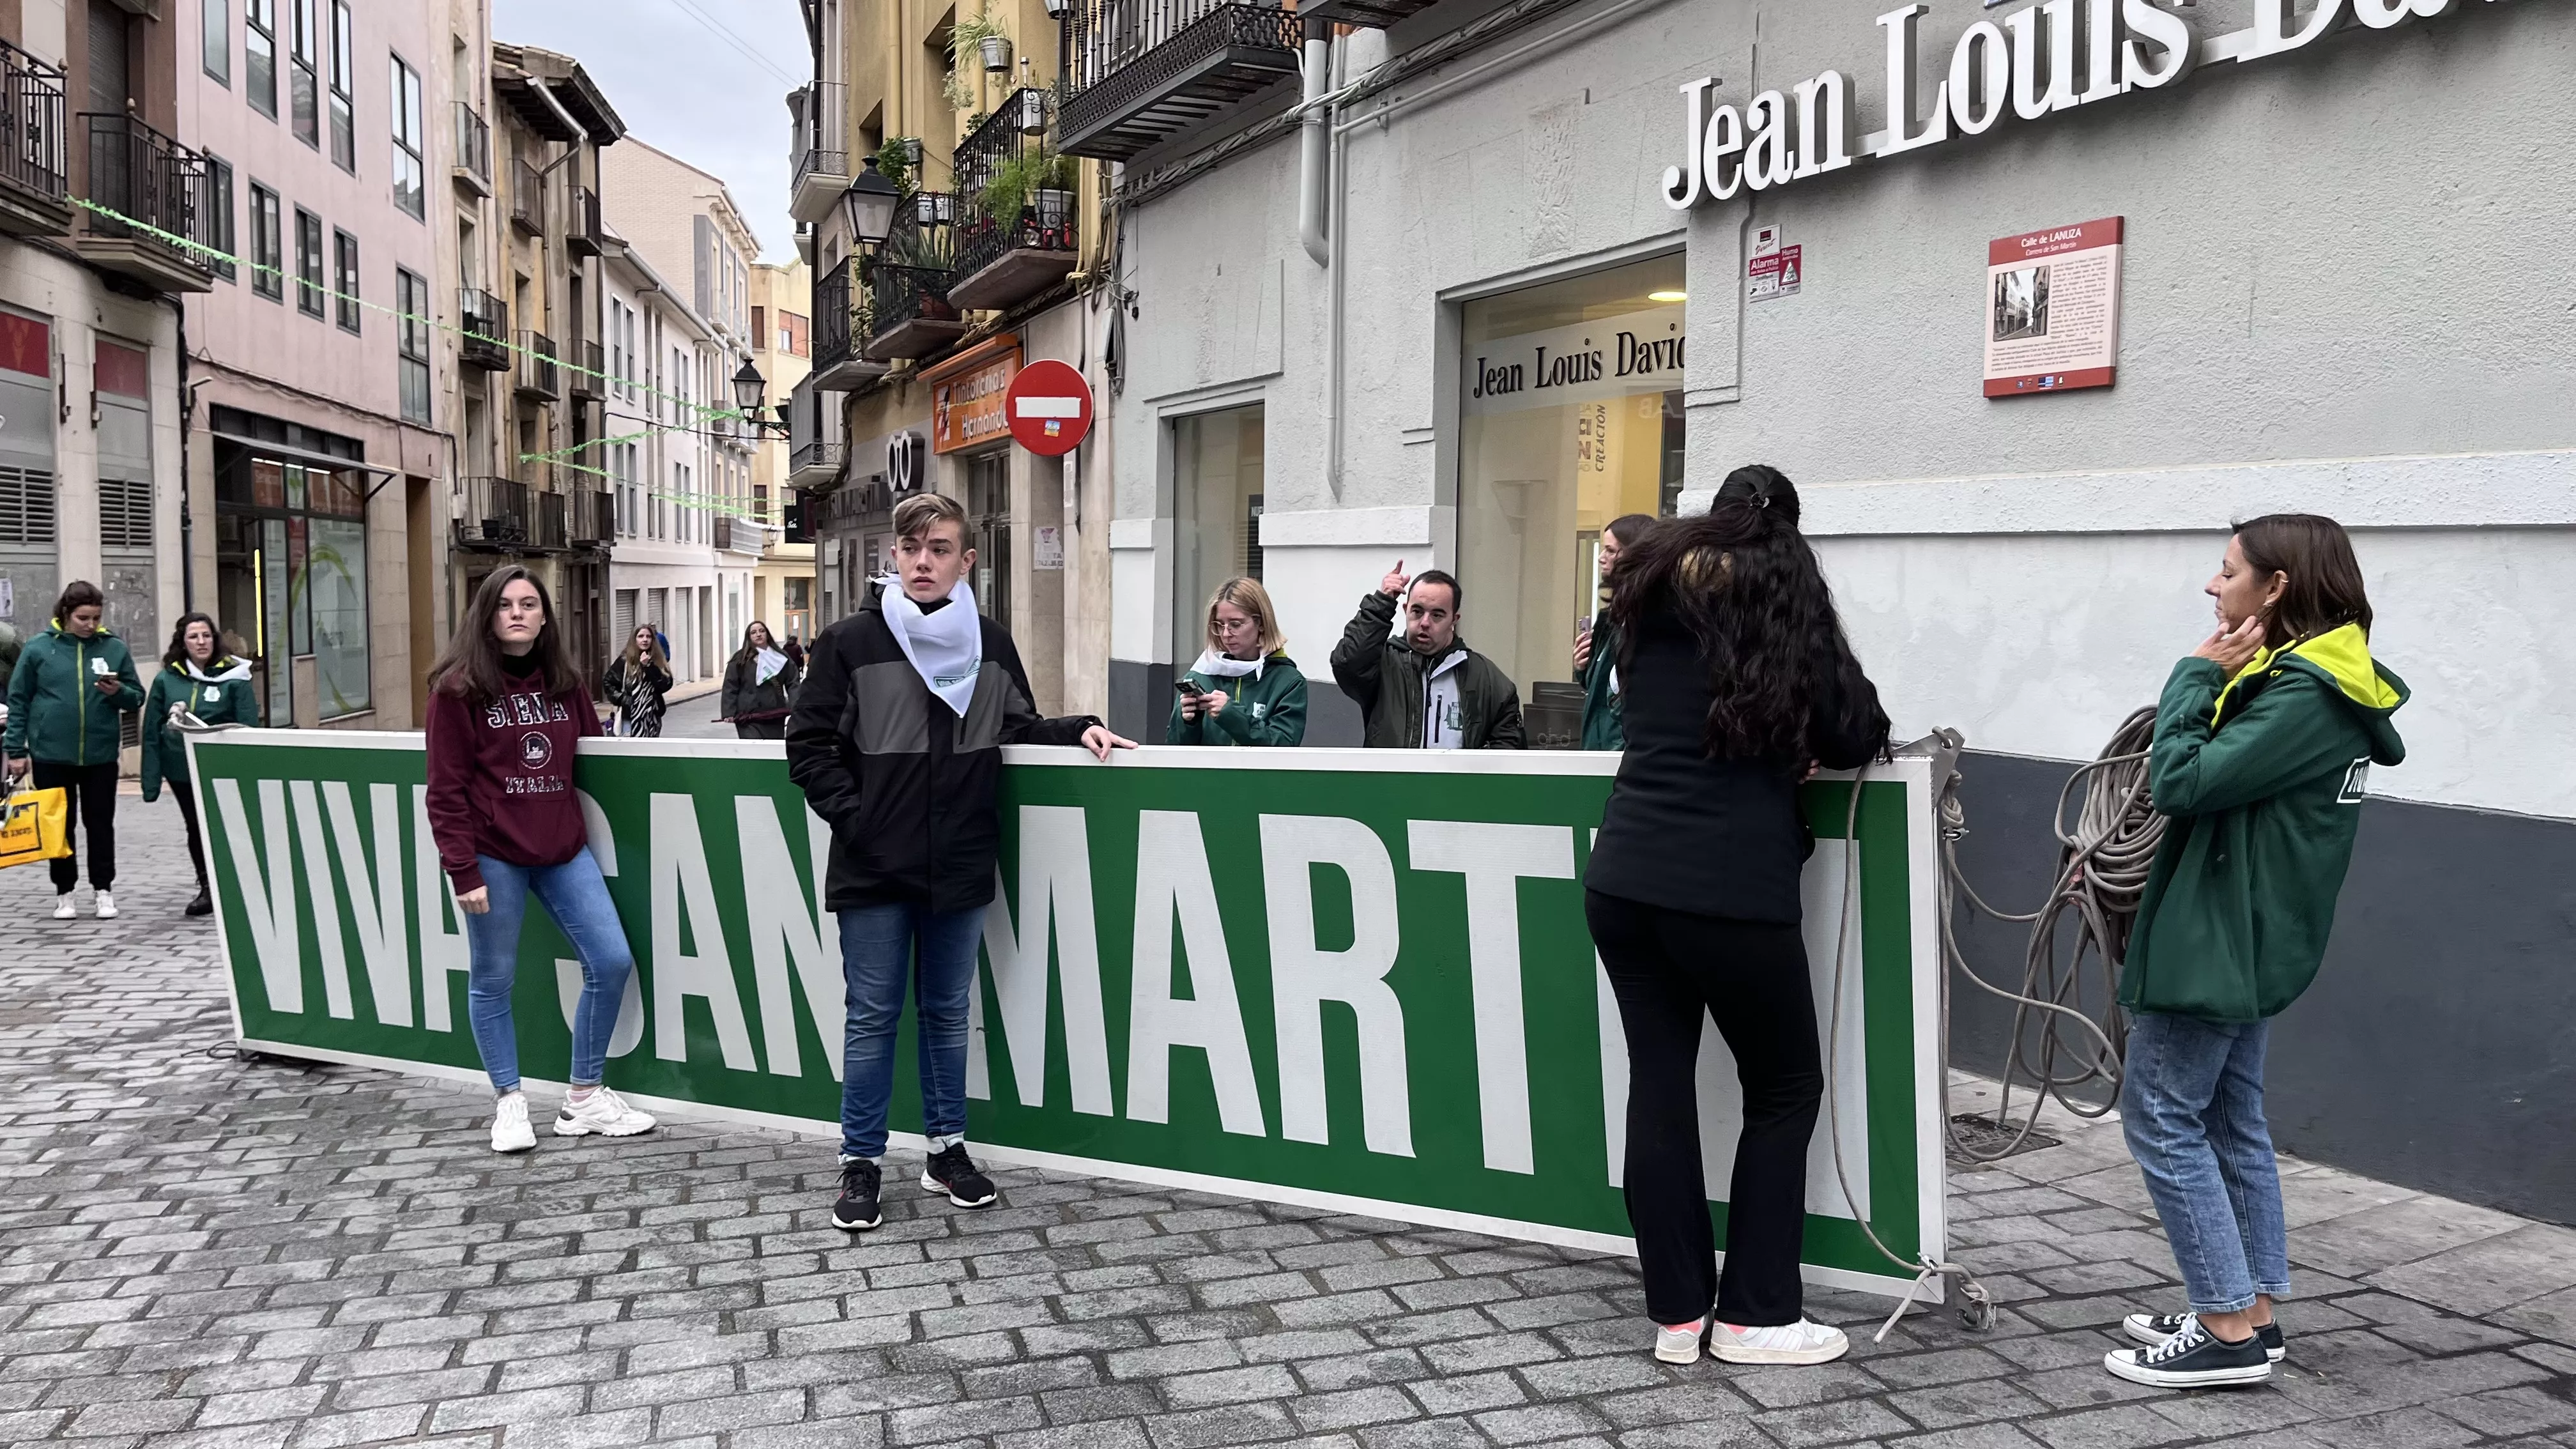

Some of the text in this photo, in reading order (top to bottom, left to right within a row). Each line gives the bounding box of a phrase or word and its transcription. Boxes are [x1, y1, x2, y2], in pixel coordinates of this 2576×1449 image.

[1662, 70, 1855, 210] Jean
[1874, 0, 2200, 158] Louis
[2021, 227, 2082, 247] Calle de LANUZA
[1751, 257, 1779, 271] Alarma
[1473, 356, 1524, 399] Jean
[1534, 337, 1603, 390] Louis
[484, 691, 569, 729] SIENA
[505, 775, 565, 794] ITALIA
